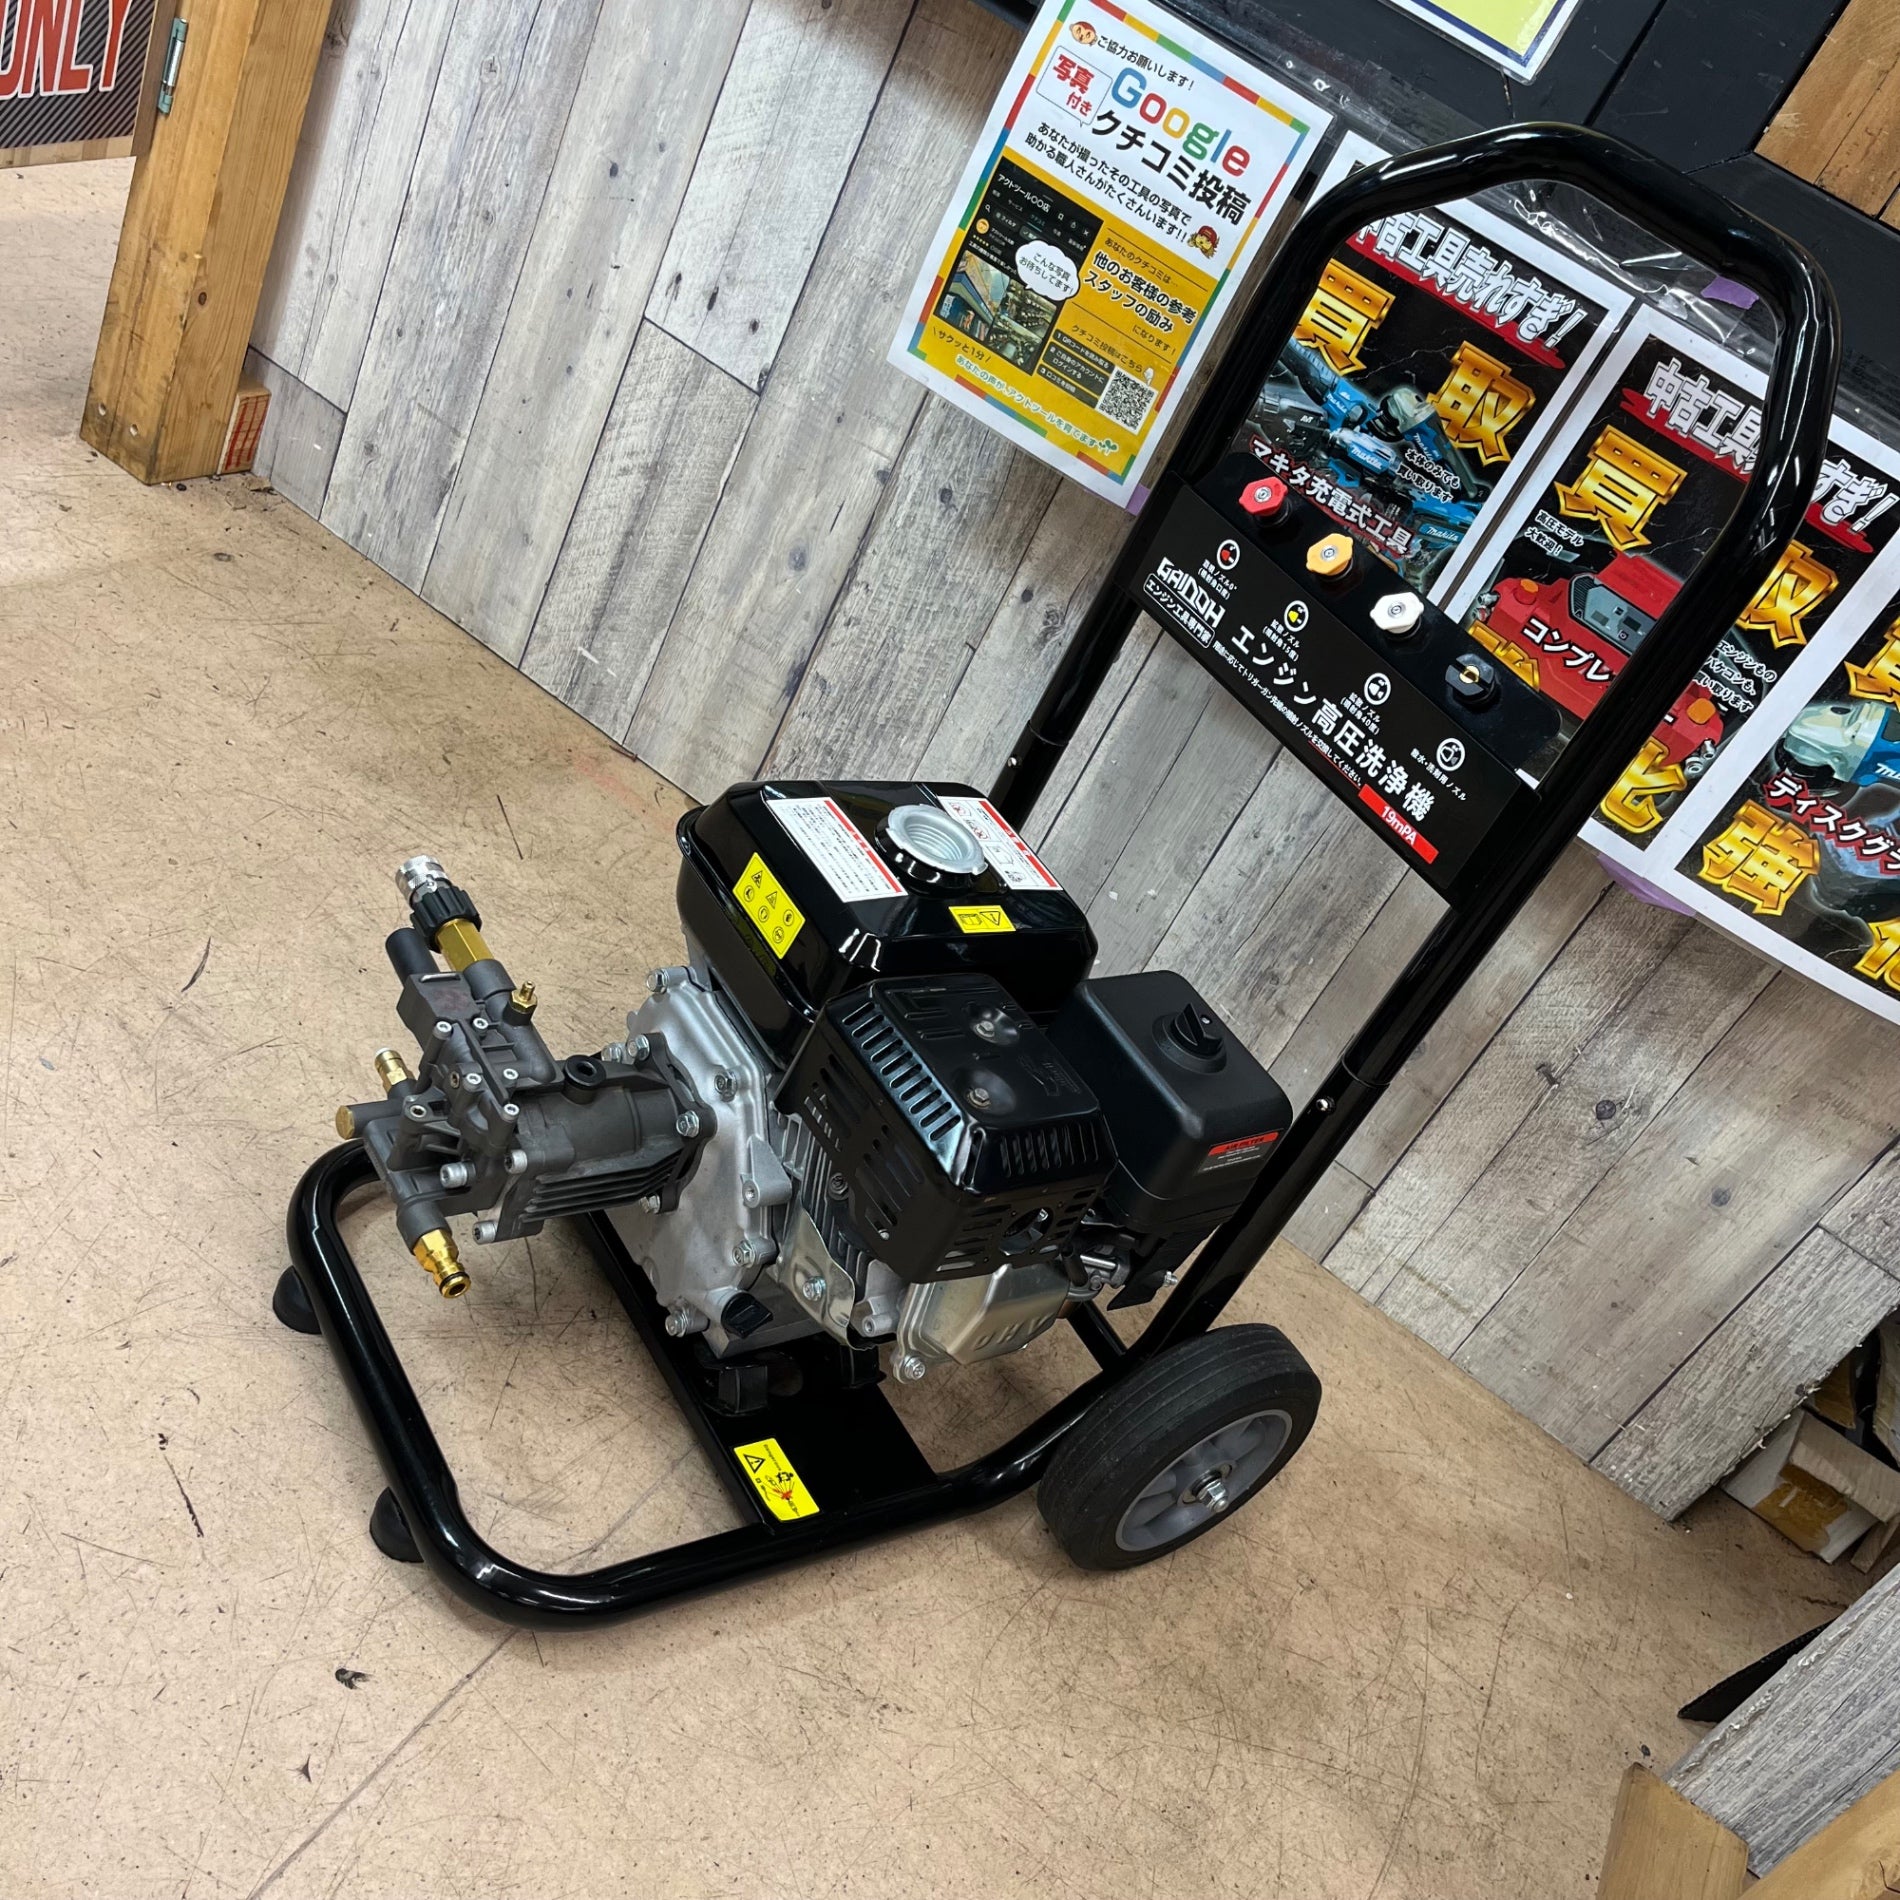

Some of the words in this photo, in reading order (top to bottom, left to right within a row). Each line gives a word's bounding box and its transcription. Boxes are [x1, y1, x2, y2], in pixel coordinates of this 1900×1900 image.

[1050, 54, 1095, 95] 写真
[1095, 34, 1194, 91] ご協力お願いします!
[1065, 92, 1094, 116] 付き
[1107, 65, 1253, 179] Google
[1024, 132, 1188, 242] 助かる職人さんがたくさんいます!!
[1036, 121, 1192, 227] あなたが撮ったその工具の写真で
[1089, 106, 1252, 226] クチコミ投稿
[1017, 255, 1074, 295] お待ちしてます!
[1032, 252, 1071, 281] こんな写真
[1091, 251, 1197, 325] 他のお客様の参考
[1083, 270, 1175, 334] スタッフの励み
[1070, 324, 1144, 373] クチコミ投稿はこちら
[1130, 324, 1176, 355] になります!
[1291, 258, 1396, 377] 買
[1426, 340, 1537, 467] 取
[1253, 440, 1413, 554] マキタ充電式工具
[1396, 463, 1453, 504] 買い取ります
[1405, 449, 1460, 489] 本体のみでも
[1553, 424, 1688, 551] 買
[1524, 526, 1563, 556] 大歓迎!
[1535, 509, 1584, 547] 高圧モデル
[1146, 579, 1211, 644] エンジン工具専門家
[1717, 639, 1778, 683] エンジンもの
[1231, 625, 1435, 822] エンジン高圧洗浄機
[1381, 806, 1418, 845] 19mPA
[1698, 799, 1820, 916] 強
